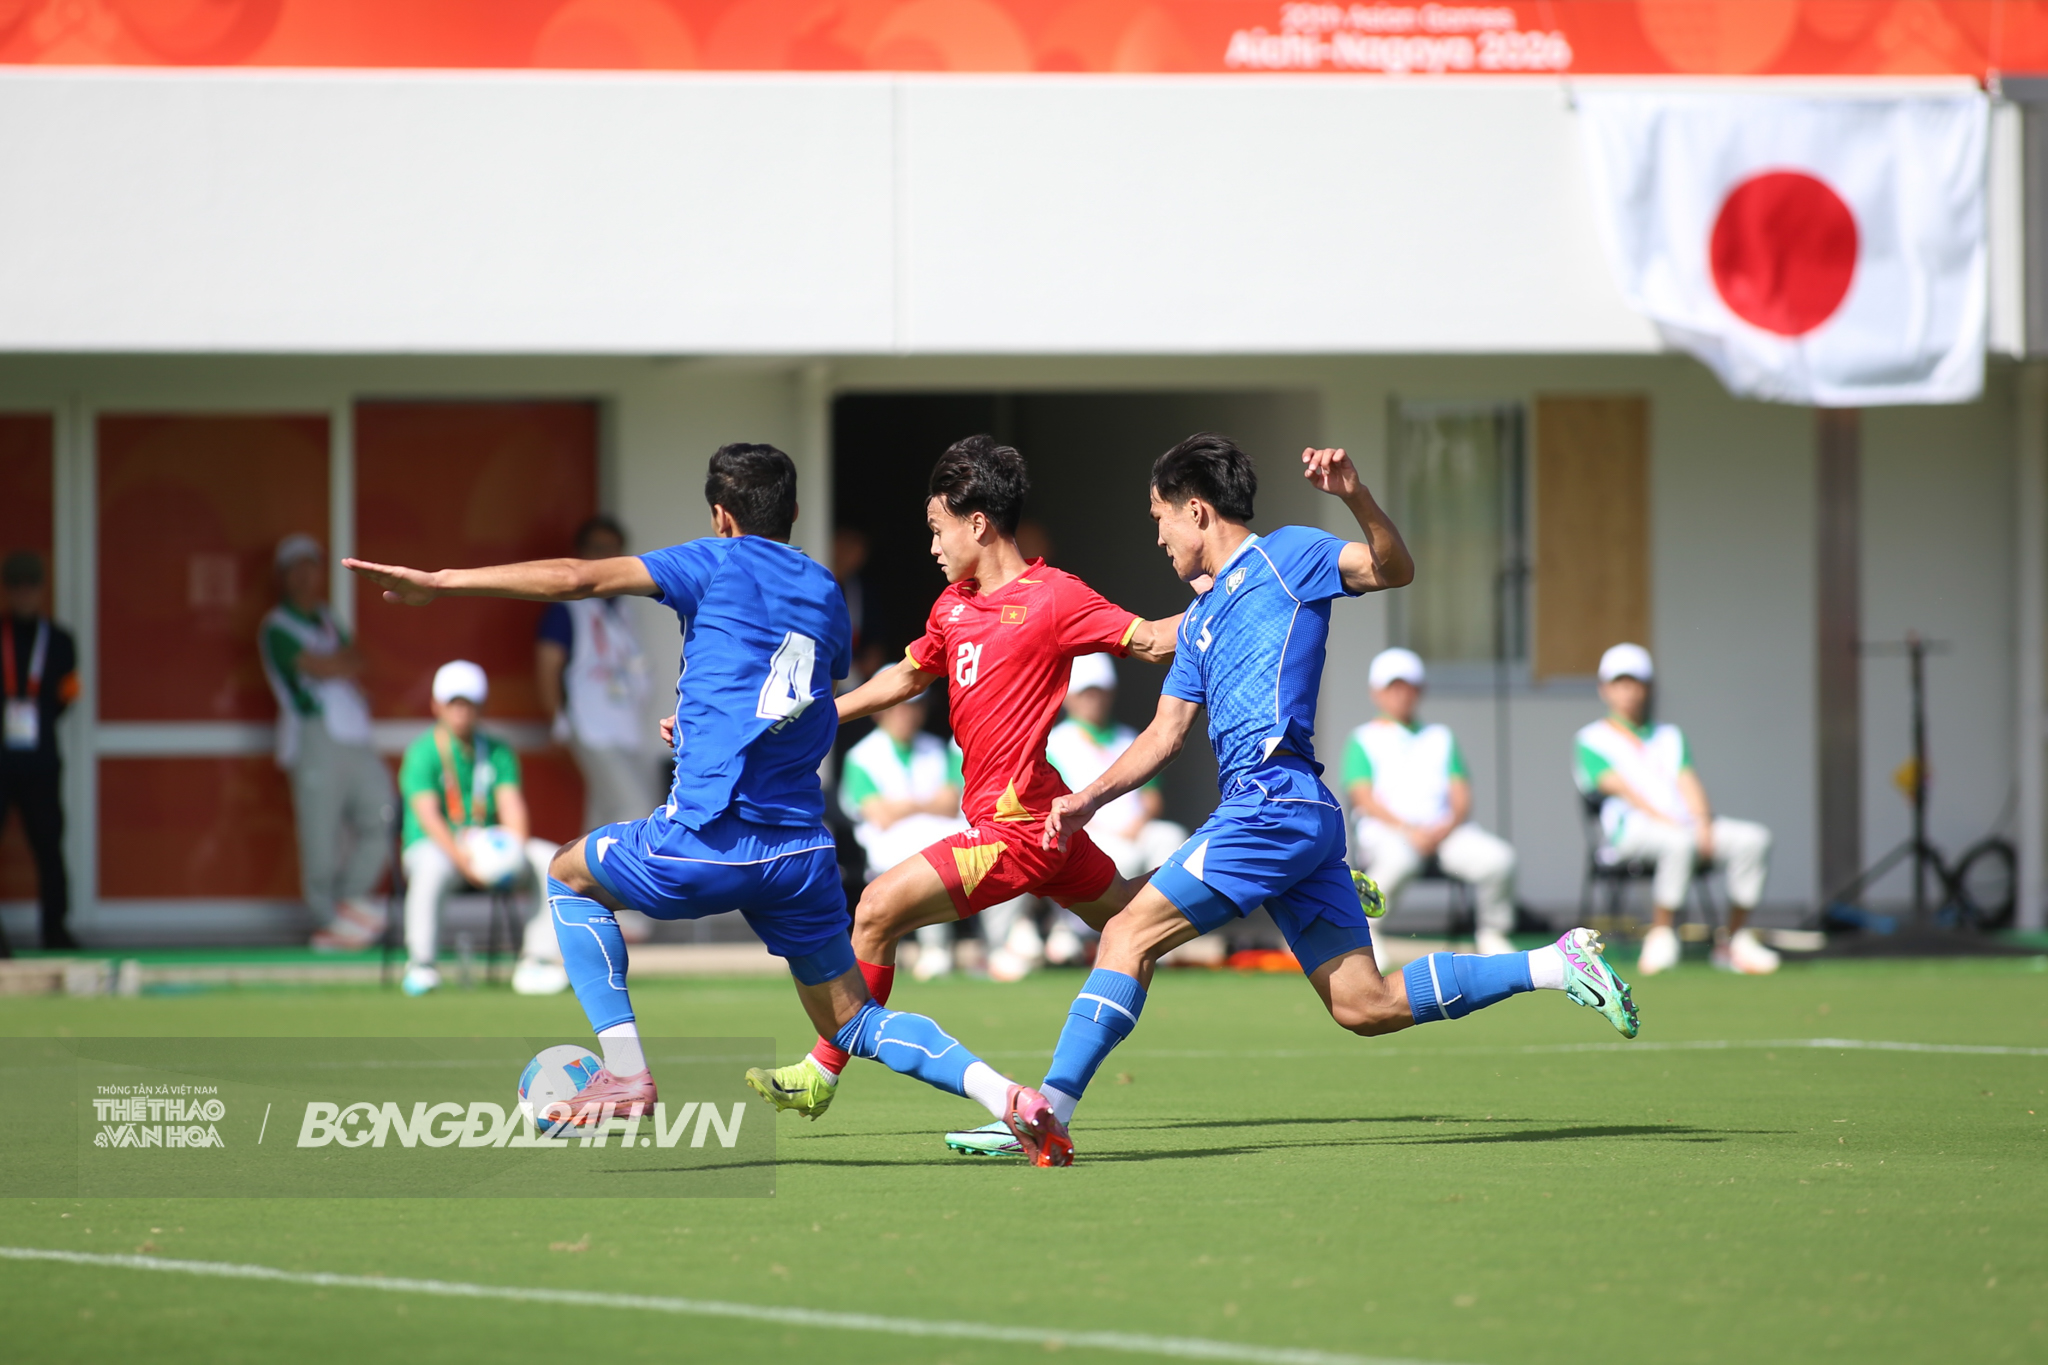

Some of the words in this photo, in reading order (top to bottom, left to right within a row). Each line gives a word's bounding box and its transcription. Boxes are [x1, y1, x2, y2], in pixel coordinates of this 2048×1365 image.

[1345, 2, 1418, 32] Asian
[1419, 3, 1516, 32] Games
[1225, 27, 1475, 72] Aichi-Nagoya
[1477, 30, 1573, 71] 2026
[756, 630, 816, 733] 4
[956, 641, 983, 688] 21
